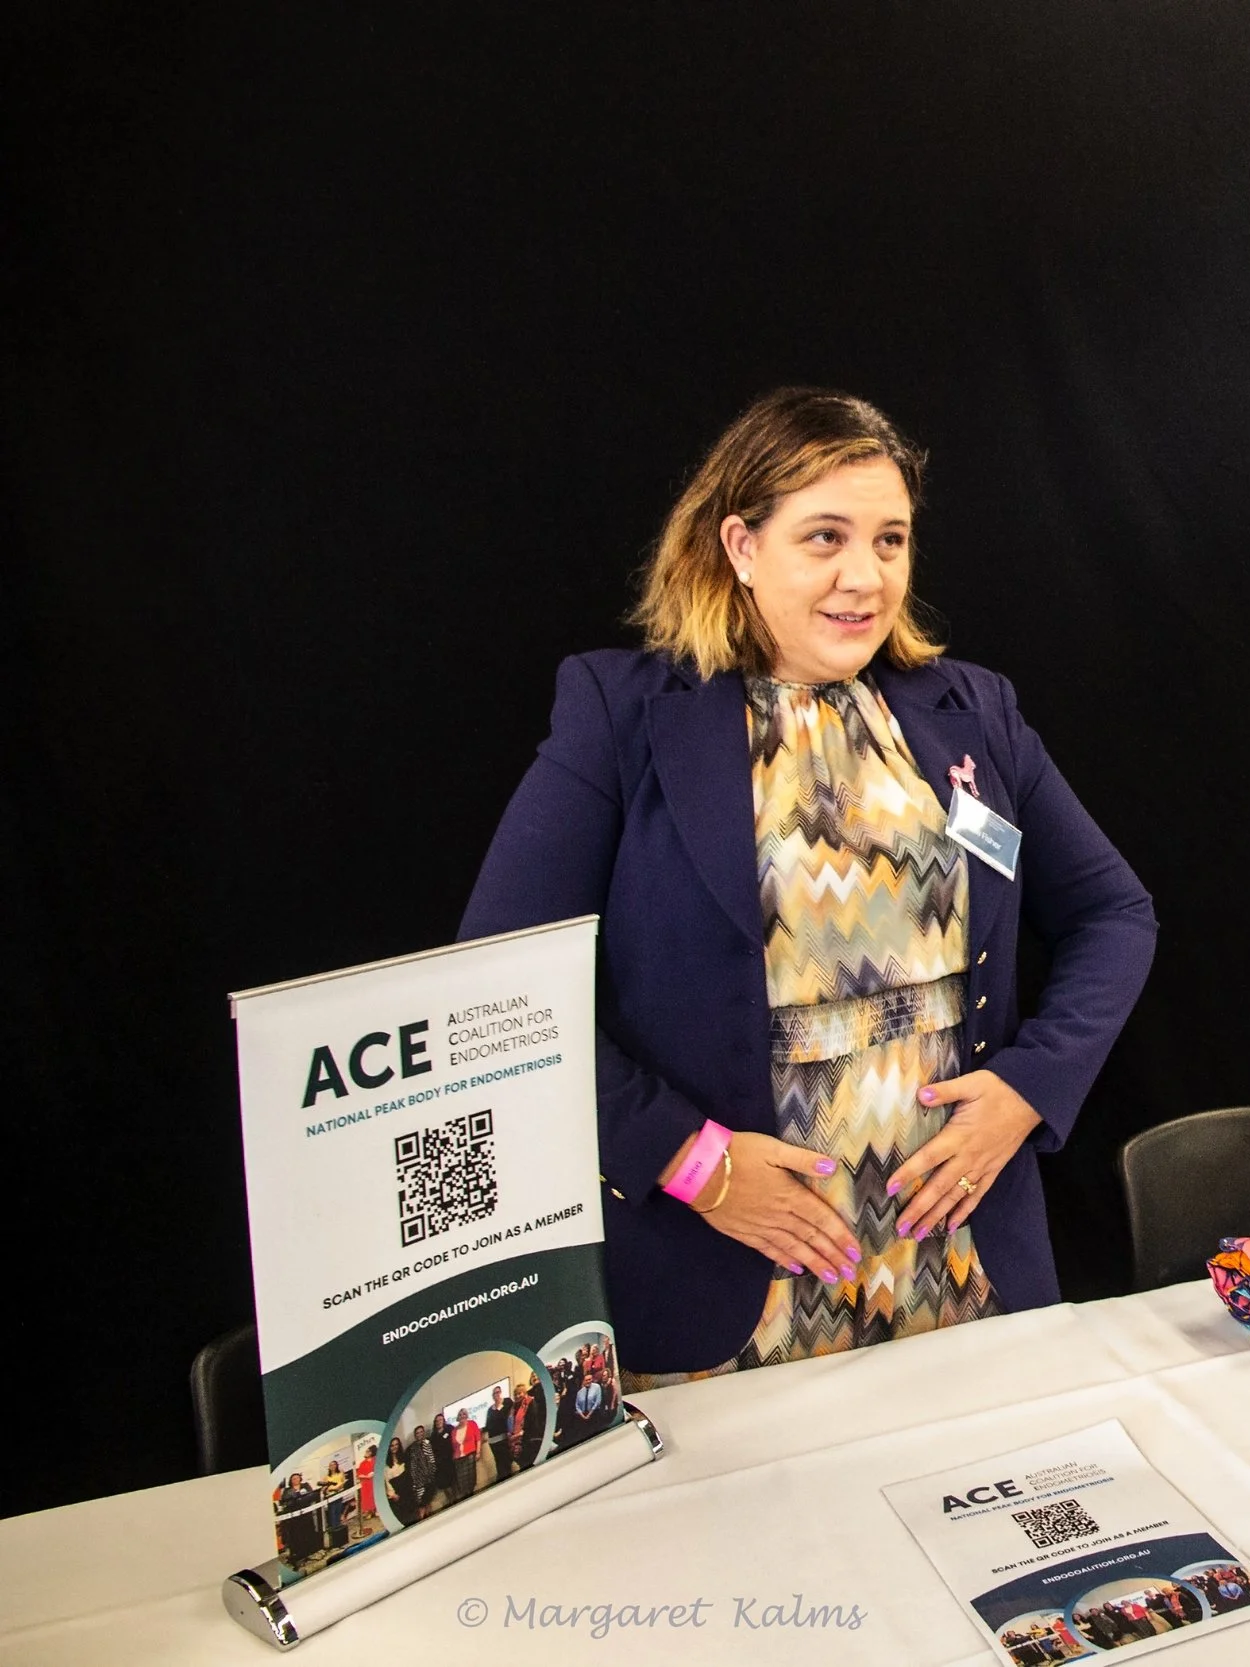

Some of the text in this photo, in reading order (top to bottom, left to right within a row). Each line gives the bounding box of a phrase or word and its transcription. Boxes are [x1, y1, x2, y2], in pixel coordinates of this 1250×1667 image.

[447, 995, 528, 1026] AUSTRALIAN
[448, 1009, 553, 1046] COALITION FOR
[301, 1019, 432, 1108] ACE
[450, 1026, 559, 1065] ENDOMETRIOSIS
[306, 1053, 562, 1138] NATIONAL PEAK BODY FOR ENDOMETRIOSIS
[323, 1203, 584, 1310] SCAN THE QR CODE TO JOIN AS A MEMBER
[382, 1273, 539, 1345] ENDOCOALITION.ORG.AU
[1025, 1461, 1077, 1480] AUSTRALIAN
[1029, 1463, 1098, 1486] COALITION FOR
[1033, 1469, 1107, 1491] ENDOMETRIOSIS
[942, 1479, 1024, 1513] ACE
[950, 1476, 1115, 1521] NATIONAL PEAK BODY FOR ENDOMETRIOSIS
[991, 1562, 1018, 1574] SCAN
[1019, 1557, 1036, 1567] THE
[1037, 1554, 1049, 1562] QR
[1051, 1547, 1076, 1558] CODE
[1091, 1536, 1112, 1546] JOIN
[1113, 1533, 1125, 1541] AS
[1133, 1520, 1169, 1535] MEMBER
[1042, 1549, 1151, 1585] ENDOCOALITION.ORG.AU
